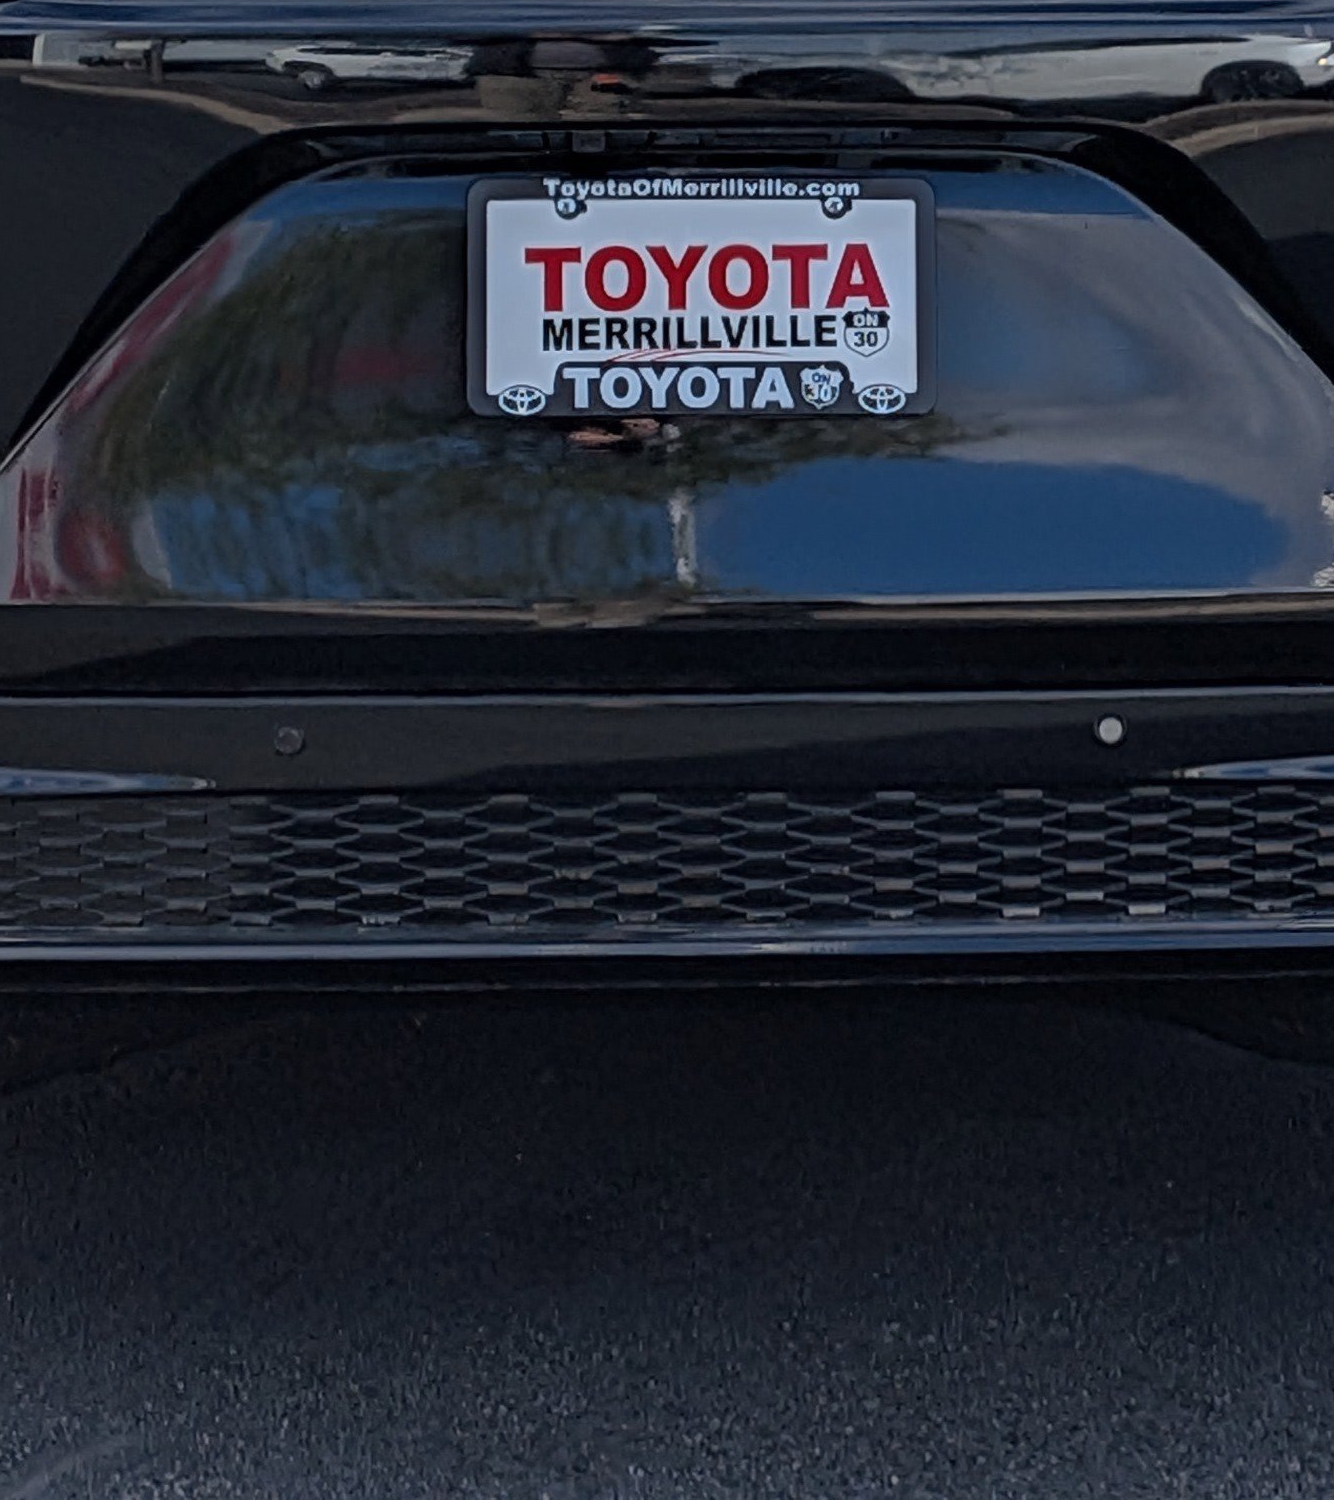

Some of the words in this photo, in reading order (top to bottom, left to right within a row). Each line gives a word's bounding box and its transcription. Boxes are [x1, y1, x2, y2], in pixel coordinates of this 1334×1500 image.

[543, 177, 860, 200] ToyotaOfMerrillville.com
[524, 243, 890, 312] TOYOTA
[542, 314, 838, 352] MERRILLVILLE
[853, 314, 879, 327] ON
[853, 331, 878, 347] 30
[562, 367, 794, 409] TOYOTA
